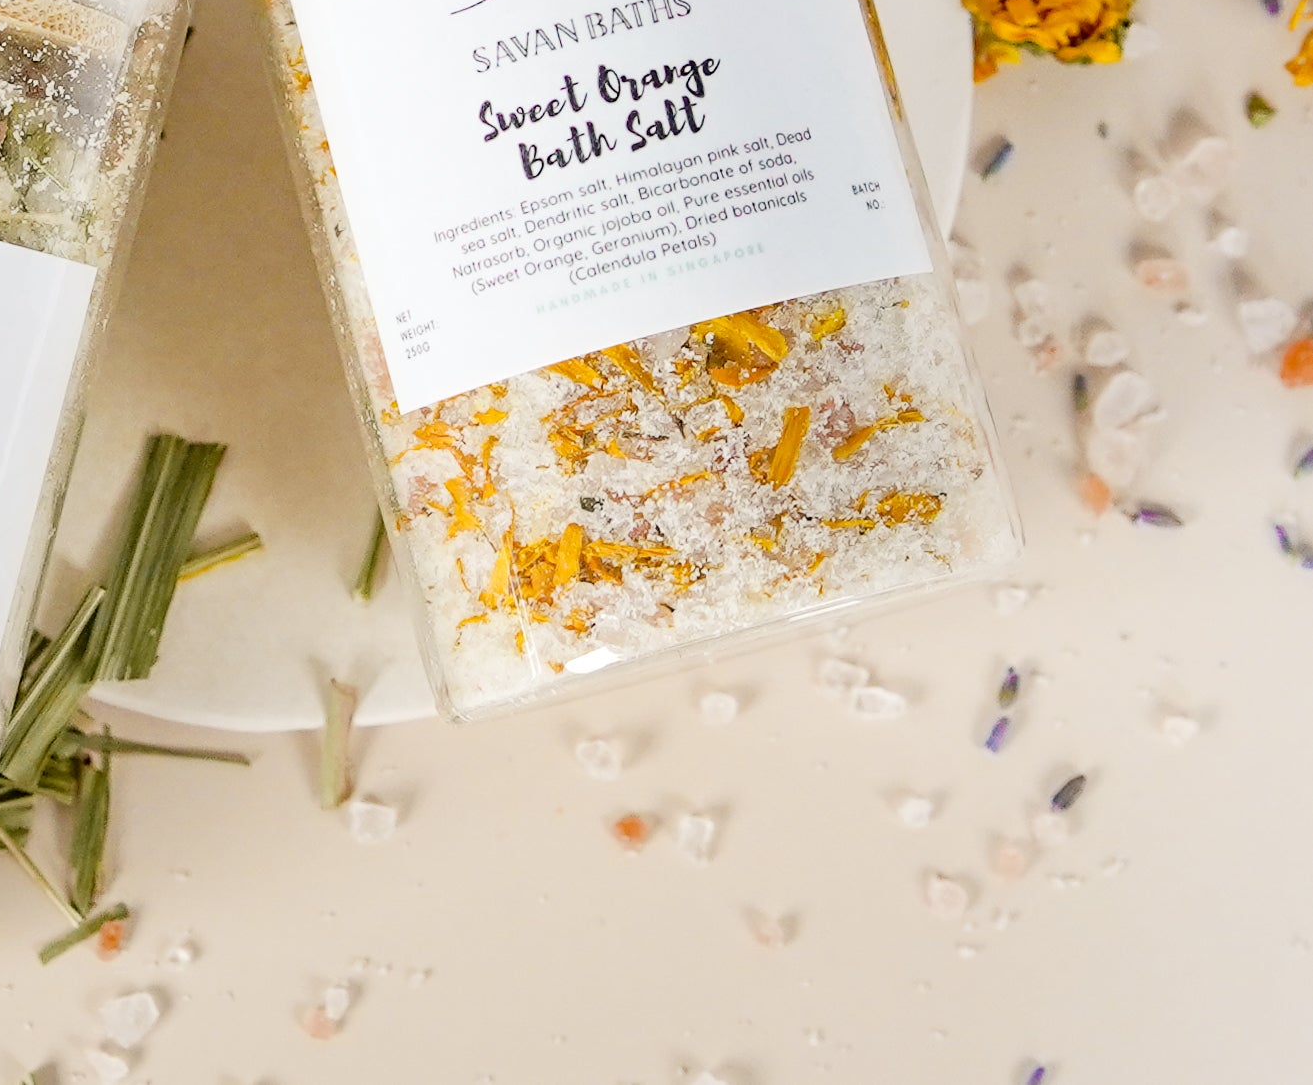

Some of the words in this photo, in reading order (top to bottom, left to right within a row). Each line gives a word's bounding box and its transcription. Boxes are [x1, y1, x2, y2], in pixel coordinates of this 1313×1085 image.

[472, 18, 580, 74] SAVAN
[478, 74, 589, 143] Sweet
[596, 57, 722, 104] Orange
[517, 120, 618, 181] Bath
[624, 94, 707, 153] Salt
[460, 238, 487, 255] sea
[523, 203, 596, 235] Dendritic
[637, 167, 734, 201] Bicarbonate
[738, 159, 753, 175] of
[519, 190, 574, 215] Epsom
[615, 154, 703, 186] Himalayan
[706, 143, 740, 165] pink
[775, 127, 812, 147] Dead
[532, 225, 597, 252] Organic
[601, 209, 653, 236] jojoba
[683, 192, 720, 209] Pure
[724, 172, 789, 200] essential
[791, 168, 815, 185] oils
[851, 181, 881, 196] BATCH
[471, 268, 520, 296] (Sweet
[684, 207, 729, 230] Dried
[731, 190, 808, 218] botanicals
[535, 277, 631, 315] HANDMADE
[640, 271, 658, 284] IN
[666, 242, 765, 277] SINGAPORE
[569, 249, 657, 286] (Calendula
[660, 231, 717, 256] Petals)
[395, 309, 412, 324] NET
